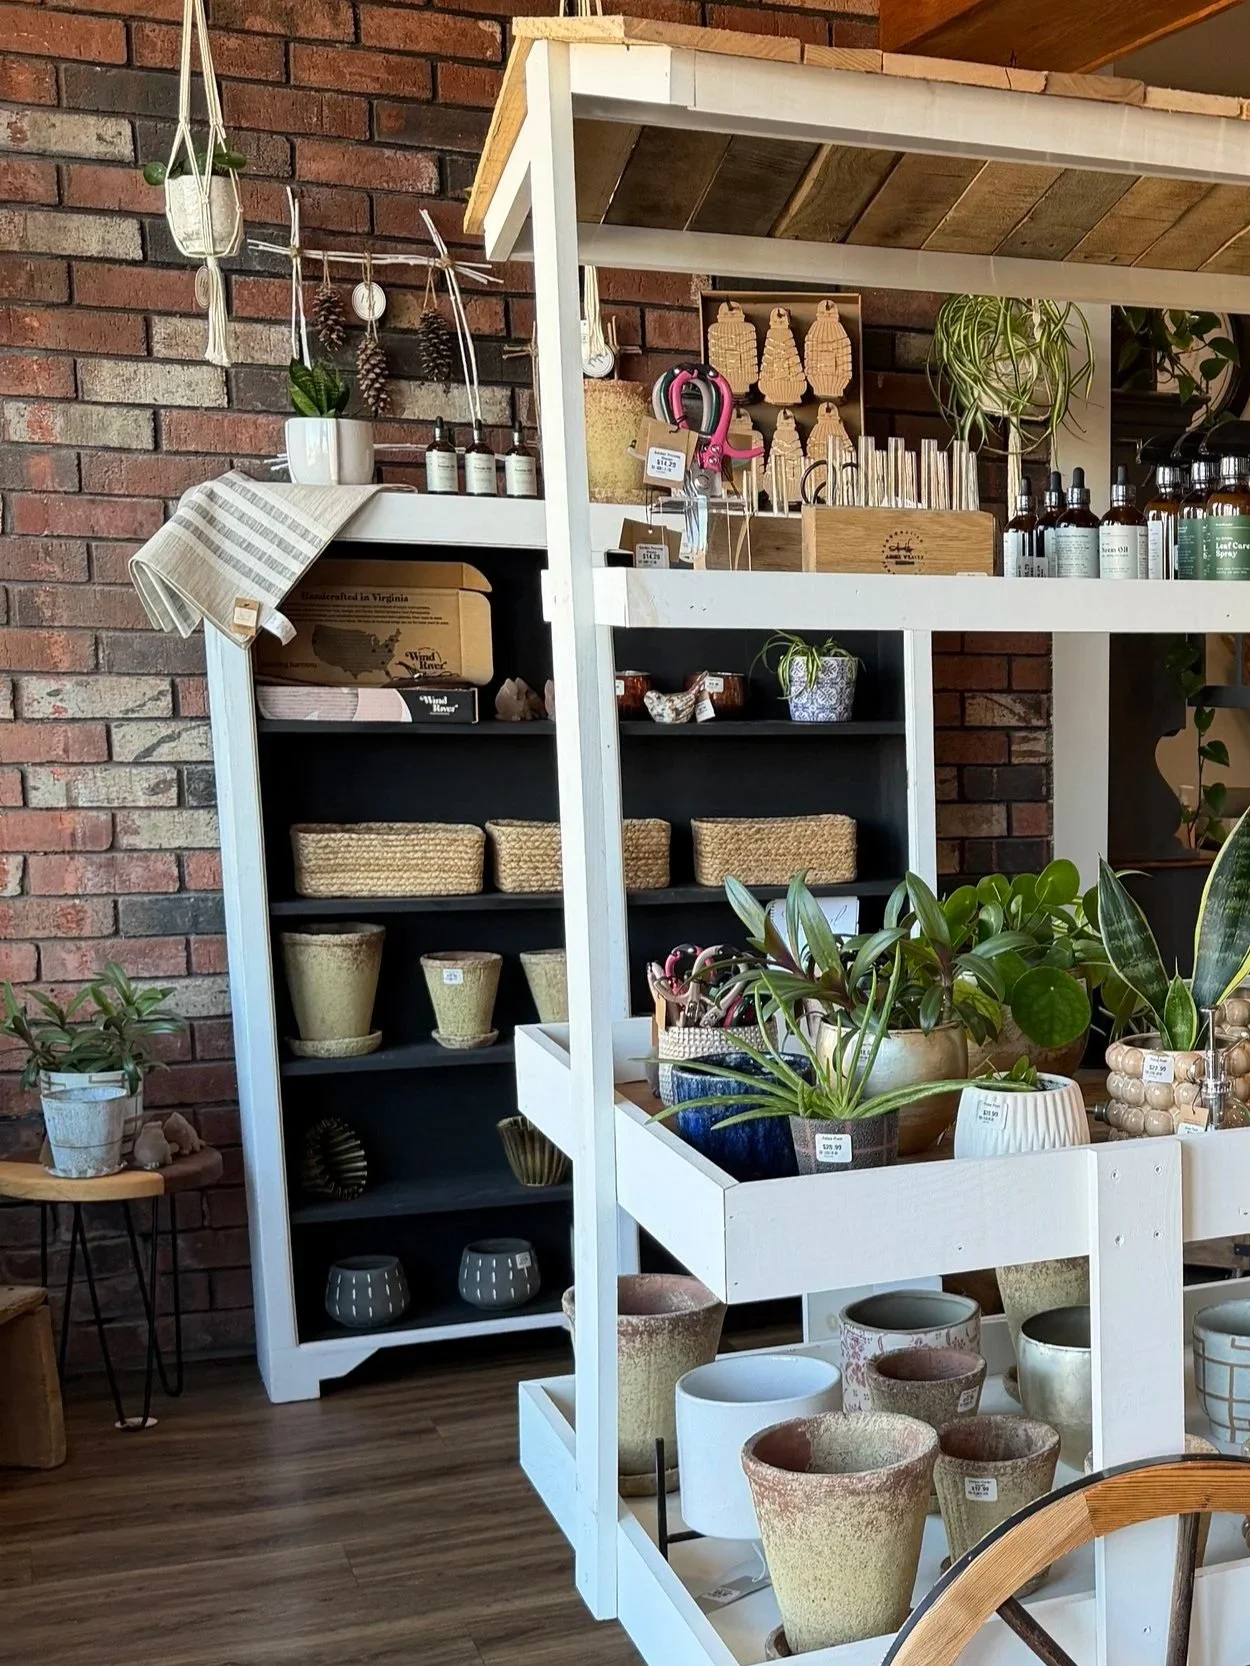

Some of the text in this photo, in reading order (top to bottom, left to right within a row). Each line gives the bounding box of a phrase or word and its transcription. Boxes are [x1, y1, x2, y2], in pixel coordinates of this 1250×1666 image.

[1215, 542, 1231, 550] Leaf
[1215, 550, 1238, 559] Spray
[360, 592, 370, 601] in
[371, 593, 409, 604] Virginia
[404, 651, 436, 661] Wind
[419, 660, 448, 670] River
[419, 695, 448, 705] Wind
[432, 704, 459, 713] River
